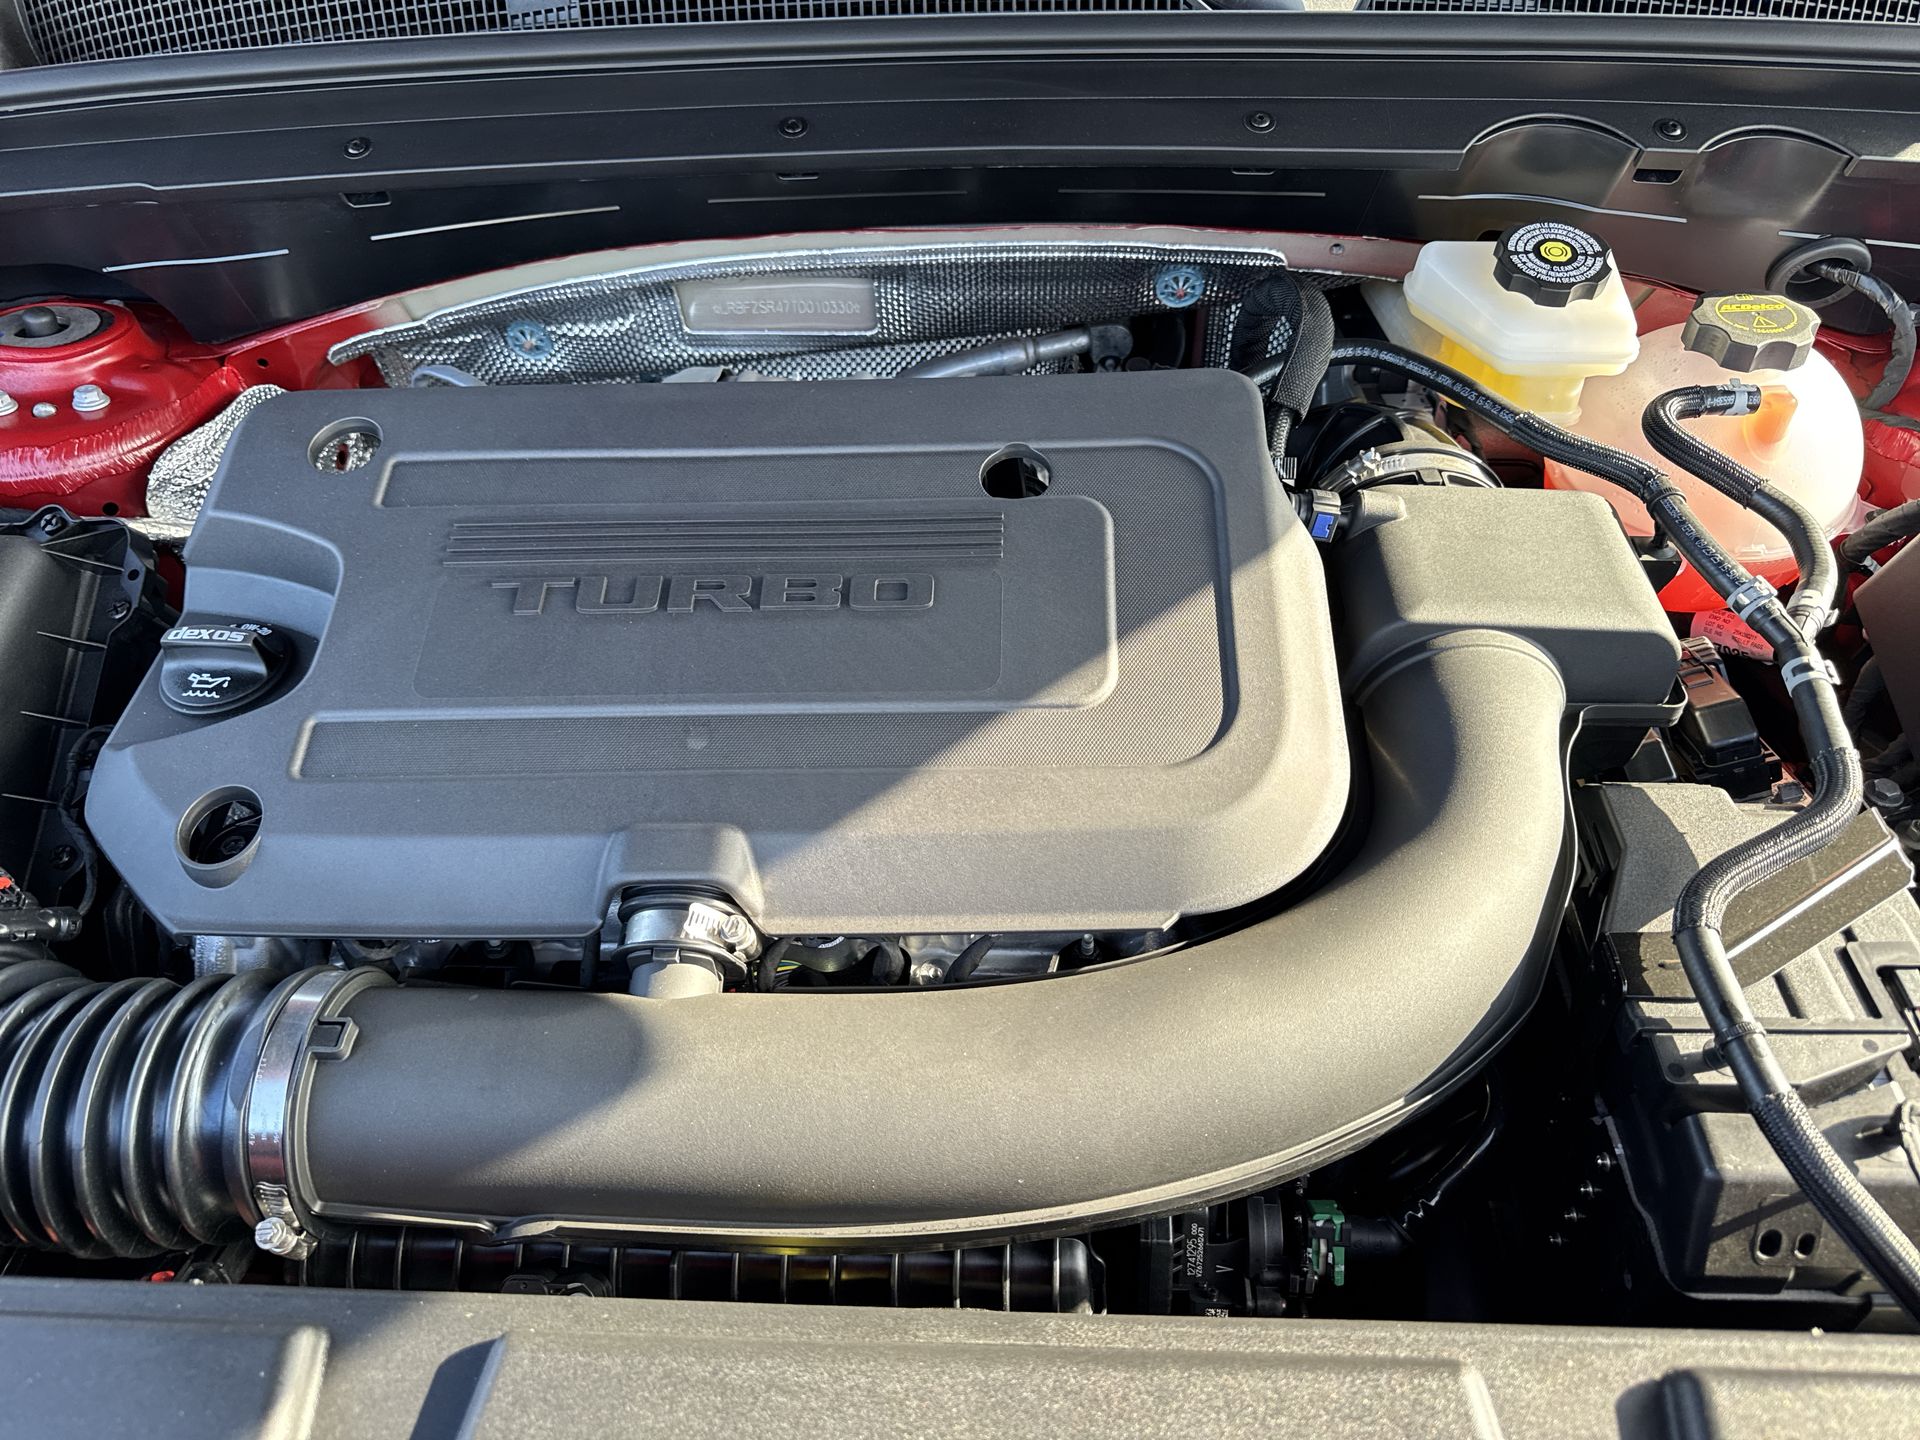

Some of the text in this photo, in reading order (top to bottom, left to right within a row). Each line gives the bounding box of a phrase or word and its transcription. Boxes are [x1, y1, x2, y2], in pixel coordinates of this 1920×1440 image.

[1537, 273, 1556, 282] FROM
[1720, 303, 1786, 311] ACDelco
[490, 573, 935, 616] TURBO
[167, 626, 249, 642] dexos
[241, 622, 273, 636] 0W-20
